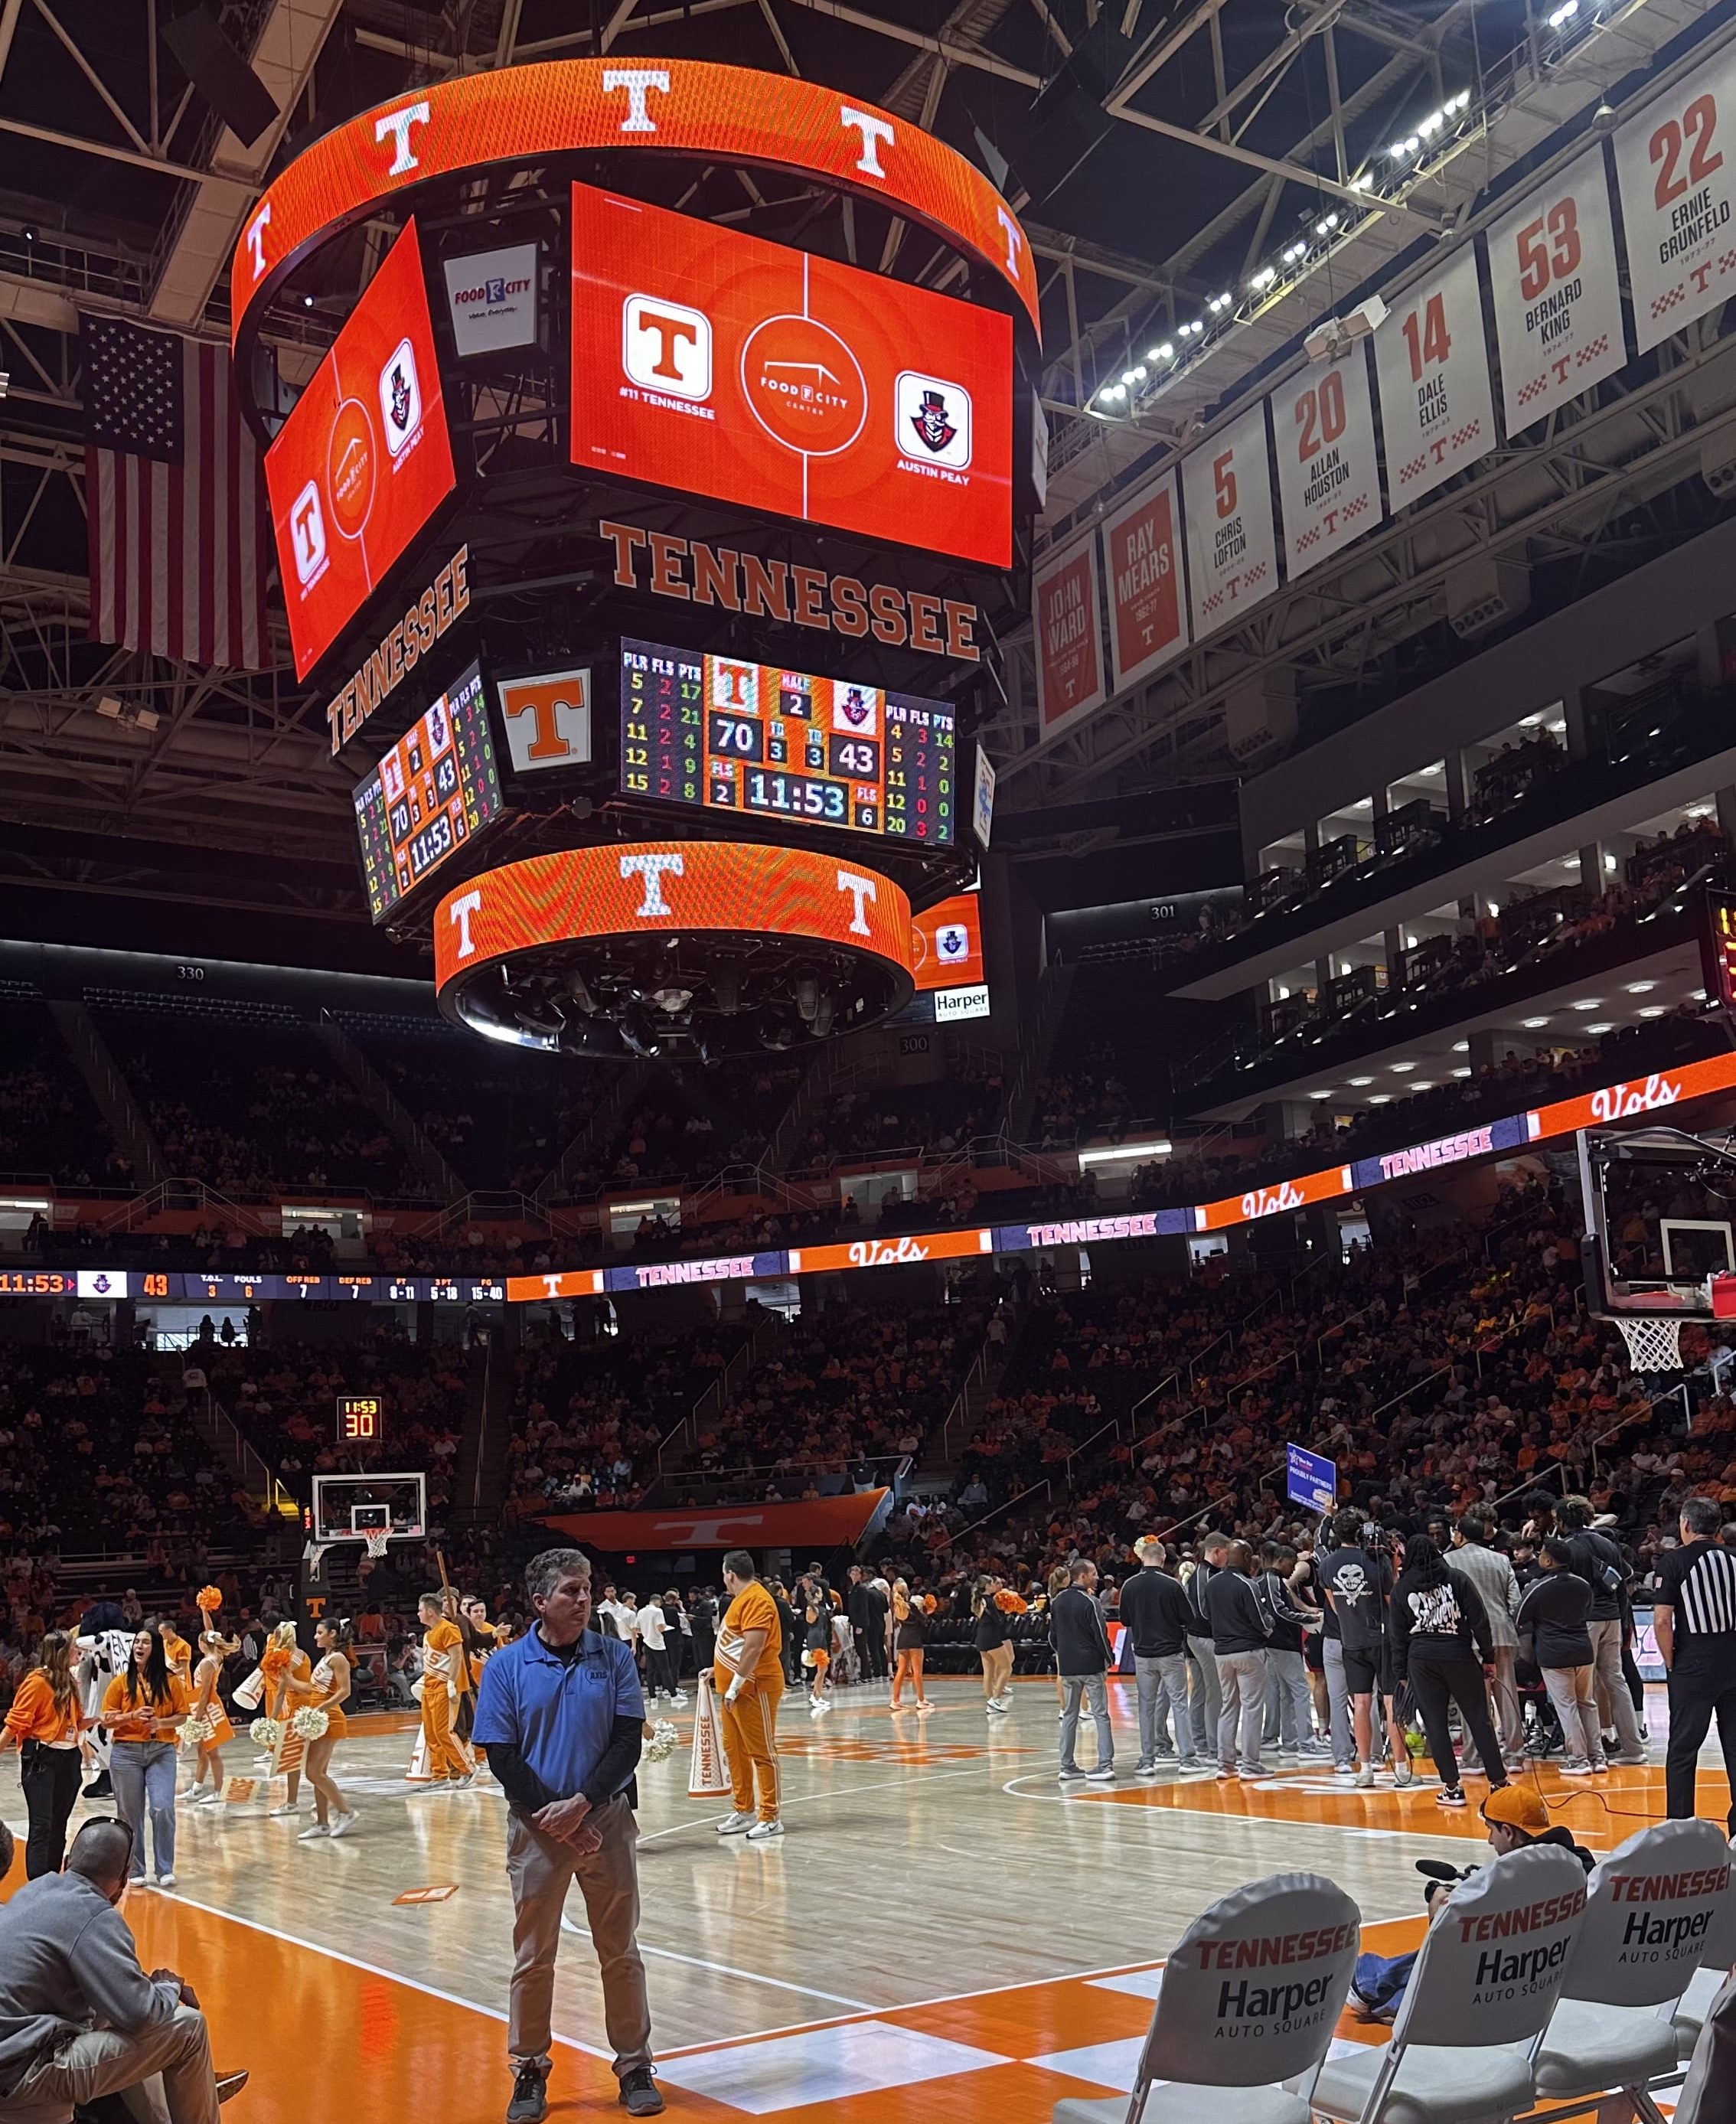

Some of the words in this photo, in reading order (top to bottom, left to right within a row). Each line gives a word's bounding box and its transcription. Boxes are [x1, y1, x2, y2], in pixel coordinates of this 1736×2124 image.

[602, 70, 671, 132] T
[375, 101, 430, 176] T
[840, 105, 895, 179] T
[1648, 93, 1723, 211] 22
[1672, 187, 1712, 232] ERNIE
[1659, 200, 1731, 264] GRUNFELD
[1516, 196, 1581, 302] 53
[455, 287, 486, 305] FOOD
[505, 279, 531, 295] CITY
[1690, 260, 1712, 294] T
[1526, 278, 1582, 333] BERNARD
[1402, 292, 1452, 383] 14
[1540, 308, 1571, 345] KING
[638, 309, 697, 381] T
[1552, 354, 1571, 385] T
[619, 386, 639, 400] #11
[641, 391, 716, 421] TENNESSEE
[760, 377, 799, 396] FOOD
[815, 392, 848, 409] CITY
[1418, 373, 1444, 407] DALE
[786, 401, 824, 416] CENTER
[1294, 370, 1346, 464] 20
[1419, 393, 1447, 428] ELLIS
[896, 459, 939, 478] AUSTIN
[940, 468, 971, 487] PEAY
[1310, 447, 1340, 484] ALLAN
[1213, 449, 1238, 520] 5
[1304, 462, 1349, 507] HOUSTON
[1127, 518, 1154, 566] RAY
[1215, 517, 1242, 549] CHRIS
[1214, 533, 1247, 569] LOFTON
[1118, 543, 1170, 606] MEARS
[599, 519, 981, 663] TENNESSEE
[1049, 574, 1082, 625] JOHN
[1048, 604, 1086, 656] WARD
[326, 542, 470, 758] TENNESSEE
[623, 651, 648, 671] PLR
[651, 657, 674, 676] FLS
[678, 662, 702, 682] PTS
[631, 671, 644, 690] 5
[660, 677, 671, 695] 2
[680, 682, 702, 700] 17
[782, 674, 810, 691] HALF
[503, 677, 586, 761] T
[631, 697, 643, 715] 7
[660, 703, 671, 720] 2
[680, 706, 701, 726] 21
[789, 694, 804, 715] 2
[886, 704, 907, 722] PLR
[909, 709, 930, 726] FLS
[933, 714, 954, 731] PTS
[627, 721, 649, 741] 11
[660, 728, 671, 746] 2
[684, 734, 697, 749] 4
[716, 718, 754, 752] 70
[769, 741, 783, 760] 3
[891, 723, 902, 739] 4
[918, 728, 928, 744] 3
[935, 732, 954, 749] 14
[625, 747, 649, 766] 12
[661, 754, 672, 770] 1
[712, 761, 734, 778] FLS
[809, 747, 822, 766] 3
[838, 742, 873, 774] 43
[891, 746, 902, 762] 5
[916, 751, 927, 768] 2
[939, 755, 950, 772] 2
[438, 758, 455, 791] 43
[626, 772, 648, 791] 15
[660, 777, 671, 795] 2
[887, 769, 907, 787] 11
[918, 775, 927, 791] 1
[938, 778, 949, 794] 0
[716, 785, 729, 803] 2
[750, 773, 844, 817] 11:53
[857, 786, 877, 802] FLS
[887, 793, 906, 811] 12
[916, 798, 927, 814] 0
[938, 801, 949, 817] 0
[392, 804, 408, 838] 70
[862, 808, 873, 825] 6
[887, 815, 906, 834] 20
[916, 821, 927, 837] 3
[938, 824, 949, 840] 2
[410, 814, 452, 874] 11:53
[619, 854, 684, 917] T
[837, 870, 877, 938] T
[1150, 905, 1176, 921] 301
[450, 889, 482, 959] T
[177, 966, 205, 980] 330
[936, 993, 987, 1011] Harper
[902, 1037, 928, 1054] 300
[1591, 1073, 1682, 1122] Vols
[1379, 1125, 1493, 1179] TENNESSEE
[1242, 1182, 1305, 1220] Vols
[1026, 1212, 1158, 1248] TENNESSEE
[849, 1236, 930, 1268] Vols
[0, 1274, 64, 1294] 11:53
[143, 1274, 168, 1297] 43
[233, 1274, 263, 1284] FOULS
[286, 1275, 303, 1284] OFF
[304, 1276, 321, 1284] REB
[543, 1274, 563, 1298] T
[635, 1256, 756, 1287] TENNESSEE
[208, 1284, 217, 1297] 3
[244, 1285, 253, 1299] 6
[299, 1284, 308, 1299] 7
[351, 1284, 359, 1300] 7
[345, 1400, 377, 1414] 11:53
[345, 1414, 374, 1437] 30
[1289, 1465, 1310, 1482] PROUDLY
[1310, 1474, 1333, 1492] PARTNERS
[305, 1597, 326, 1619] T
[112, 1633, 133, 1658] EAT
[589, 1671, 608, 1681] AXIS
[207, 1701, 226, 1728] TOP
[702, 1715, 711, 1787] TENNESSEE
[225, 1777, 256, 1803] NOISE
[1196, 1917, 1358, 1970] TENNESSEE
[1623, 1909, 1715, 1949] Harper
[1475, 1934, 1571, 1985] Harper
[1618, 1951, 1659, 1963] AUTO
[1665, 1940, 1706, 1961] SQUARE
[1217, 1973, 1334, 2021] Harper
[1472, 1987, 1516, 2005] AUTO
[1214, 2024, 1264, 2038] AUTO
[1273, 2007, 1326, 2035] SQUARE
